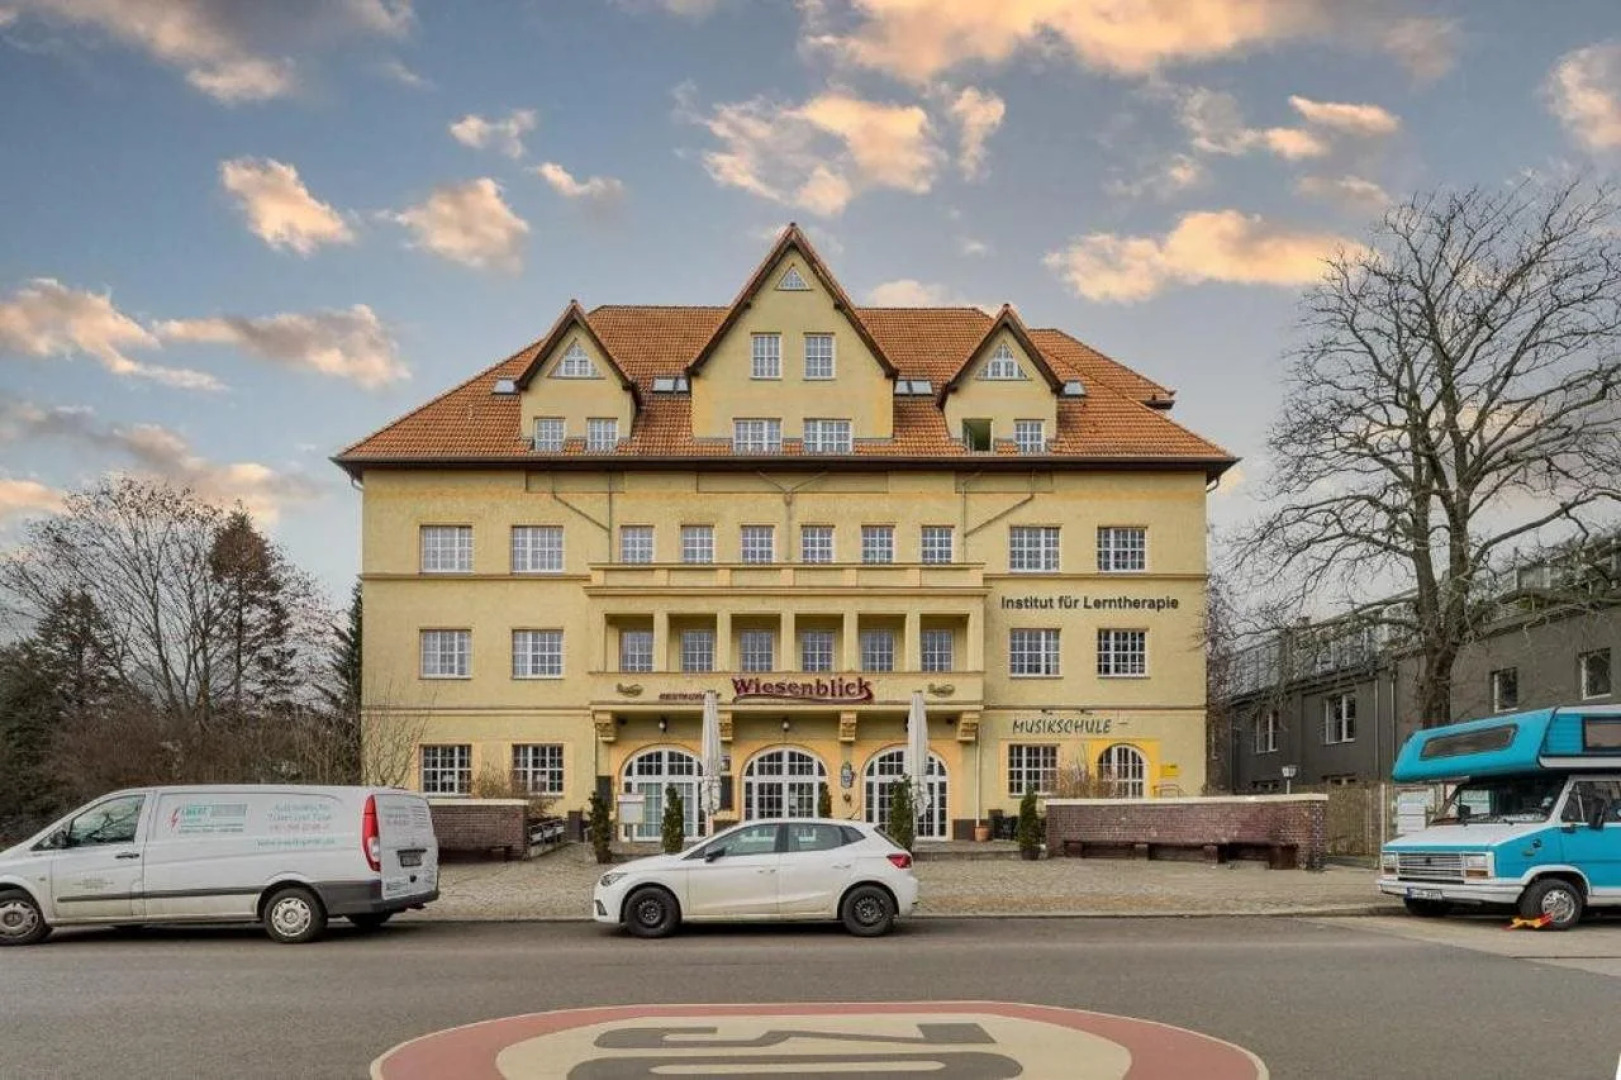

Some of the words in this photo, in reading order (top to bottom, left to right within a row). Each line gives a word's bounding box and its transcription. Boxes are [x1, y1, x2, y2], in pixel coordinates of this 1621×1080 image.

[1001, 595, 1053, 610] Institut
[1058, 595, 1079, 610] für
[1083, 595, 1180, 613] Lerntherapie
[732, 676, 874, 701] Wiesenblick
[1012, 718, 1113, 735] MUSIKSCHULE
[566, 1022, 1023, 1080] 30
